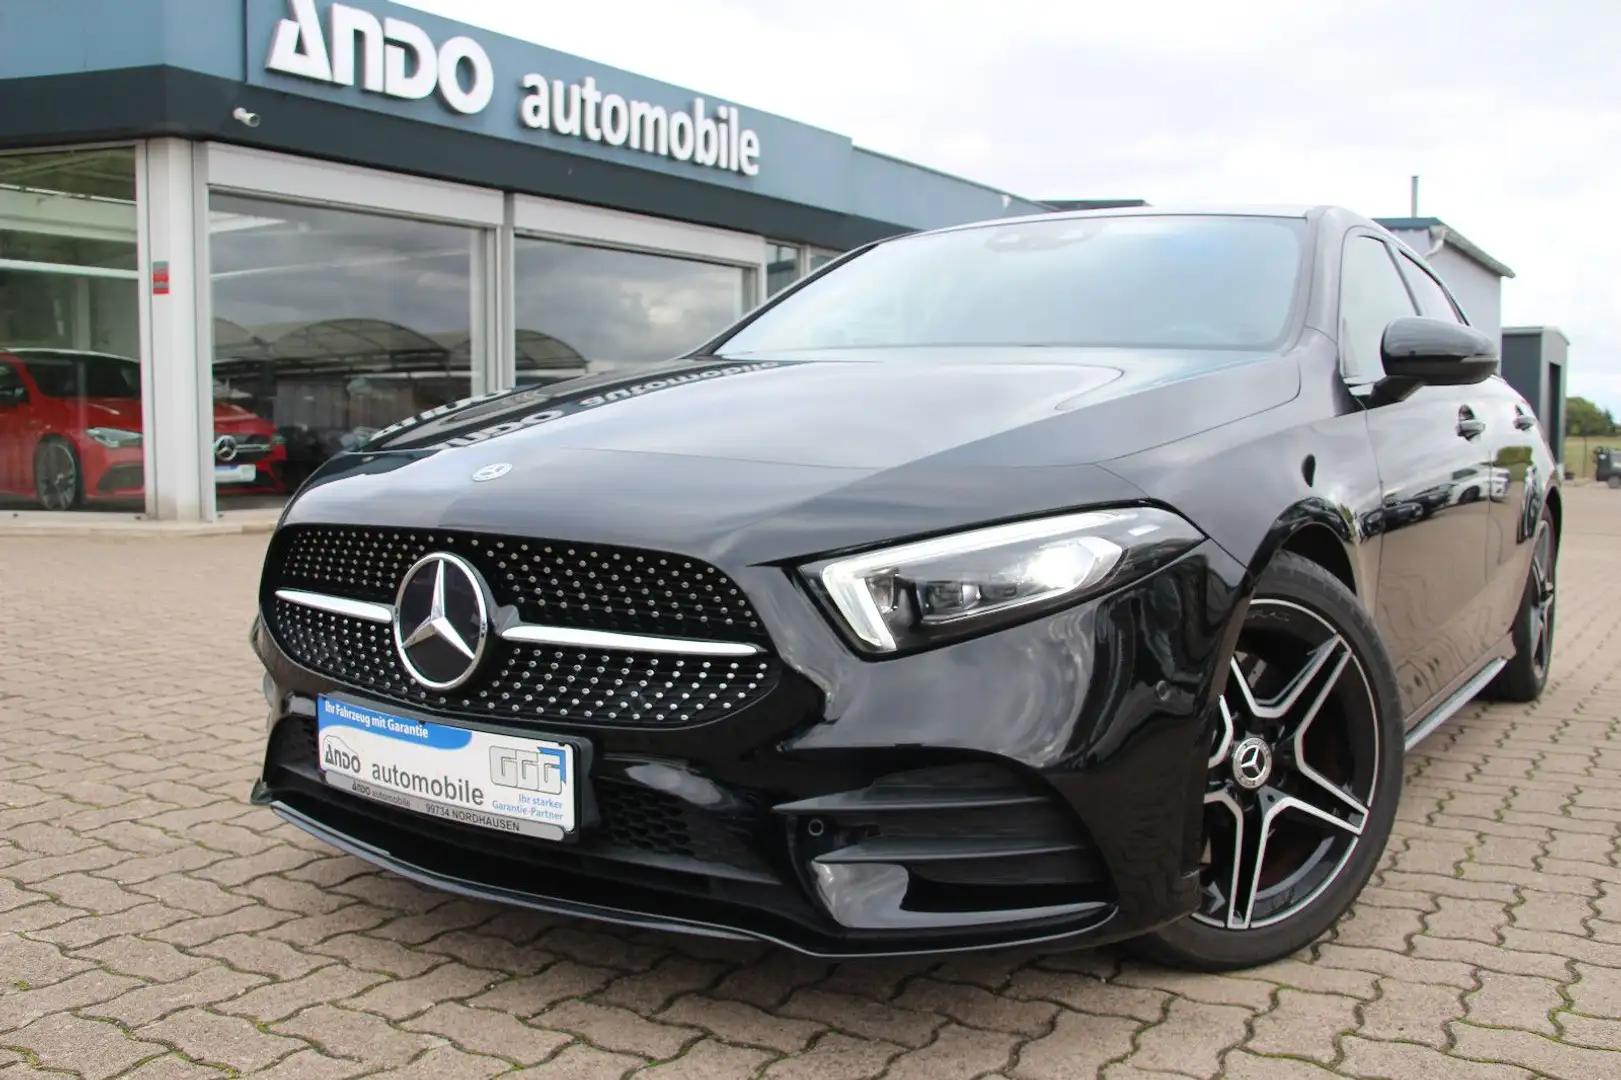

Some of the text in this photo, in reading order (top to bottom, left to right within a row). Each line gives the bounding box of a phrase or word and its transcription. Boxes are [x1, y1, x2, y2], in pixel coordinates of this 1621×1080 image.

[519, 71, 762, 177] automobile
[324, 700, 429, 738] Ihr Fahrzeug mit Garantie
[371, 763, 485, 806] automobile
[425, 803, 450, 817] 99734
[451, 808, 520, 831] NORDHAUSEN
[491, 800, 564, 820] Garantie-Partner
[518, 793, 563, 810] Ihr starker
